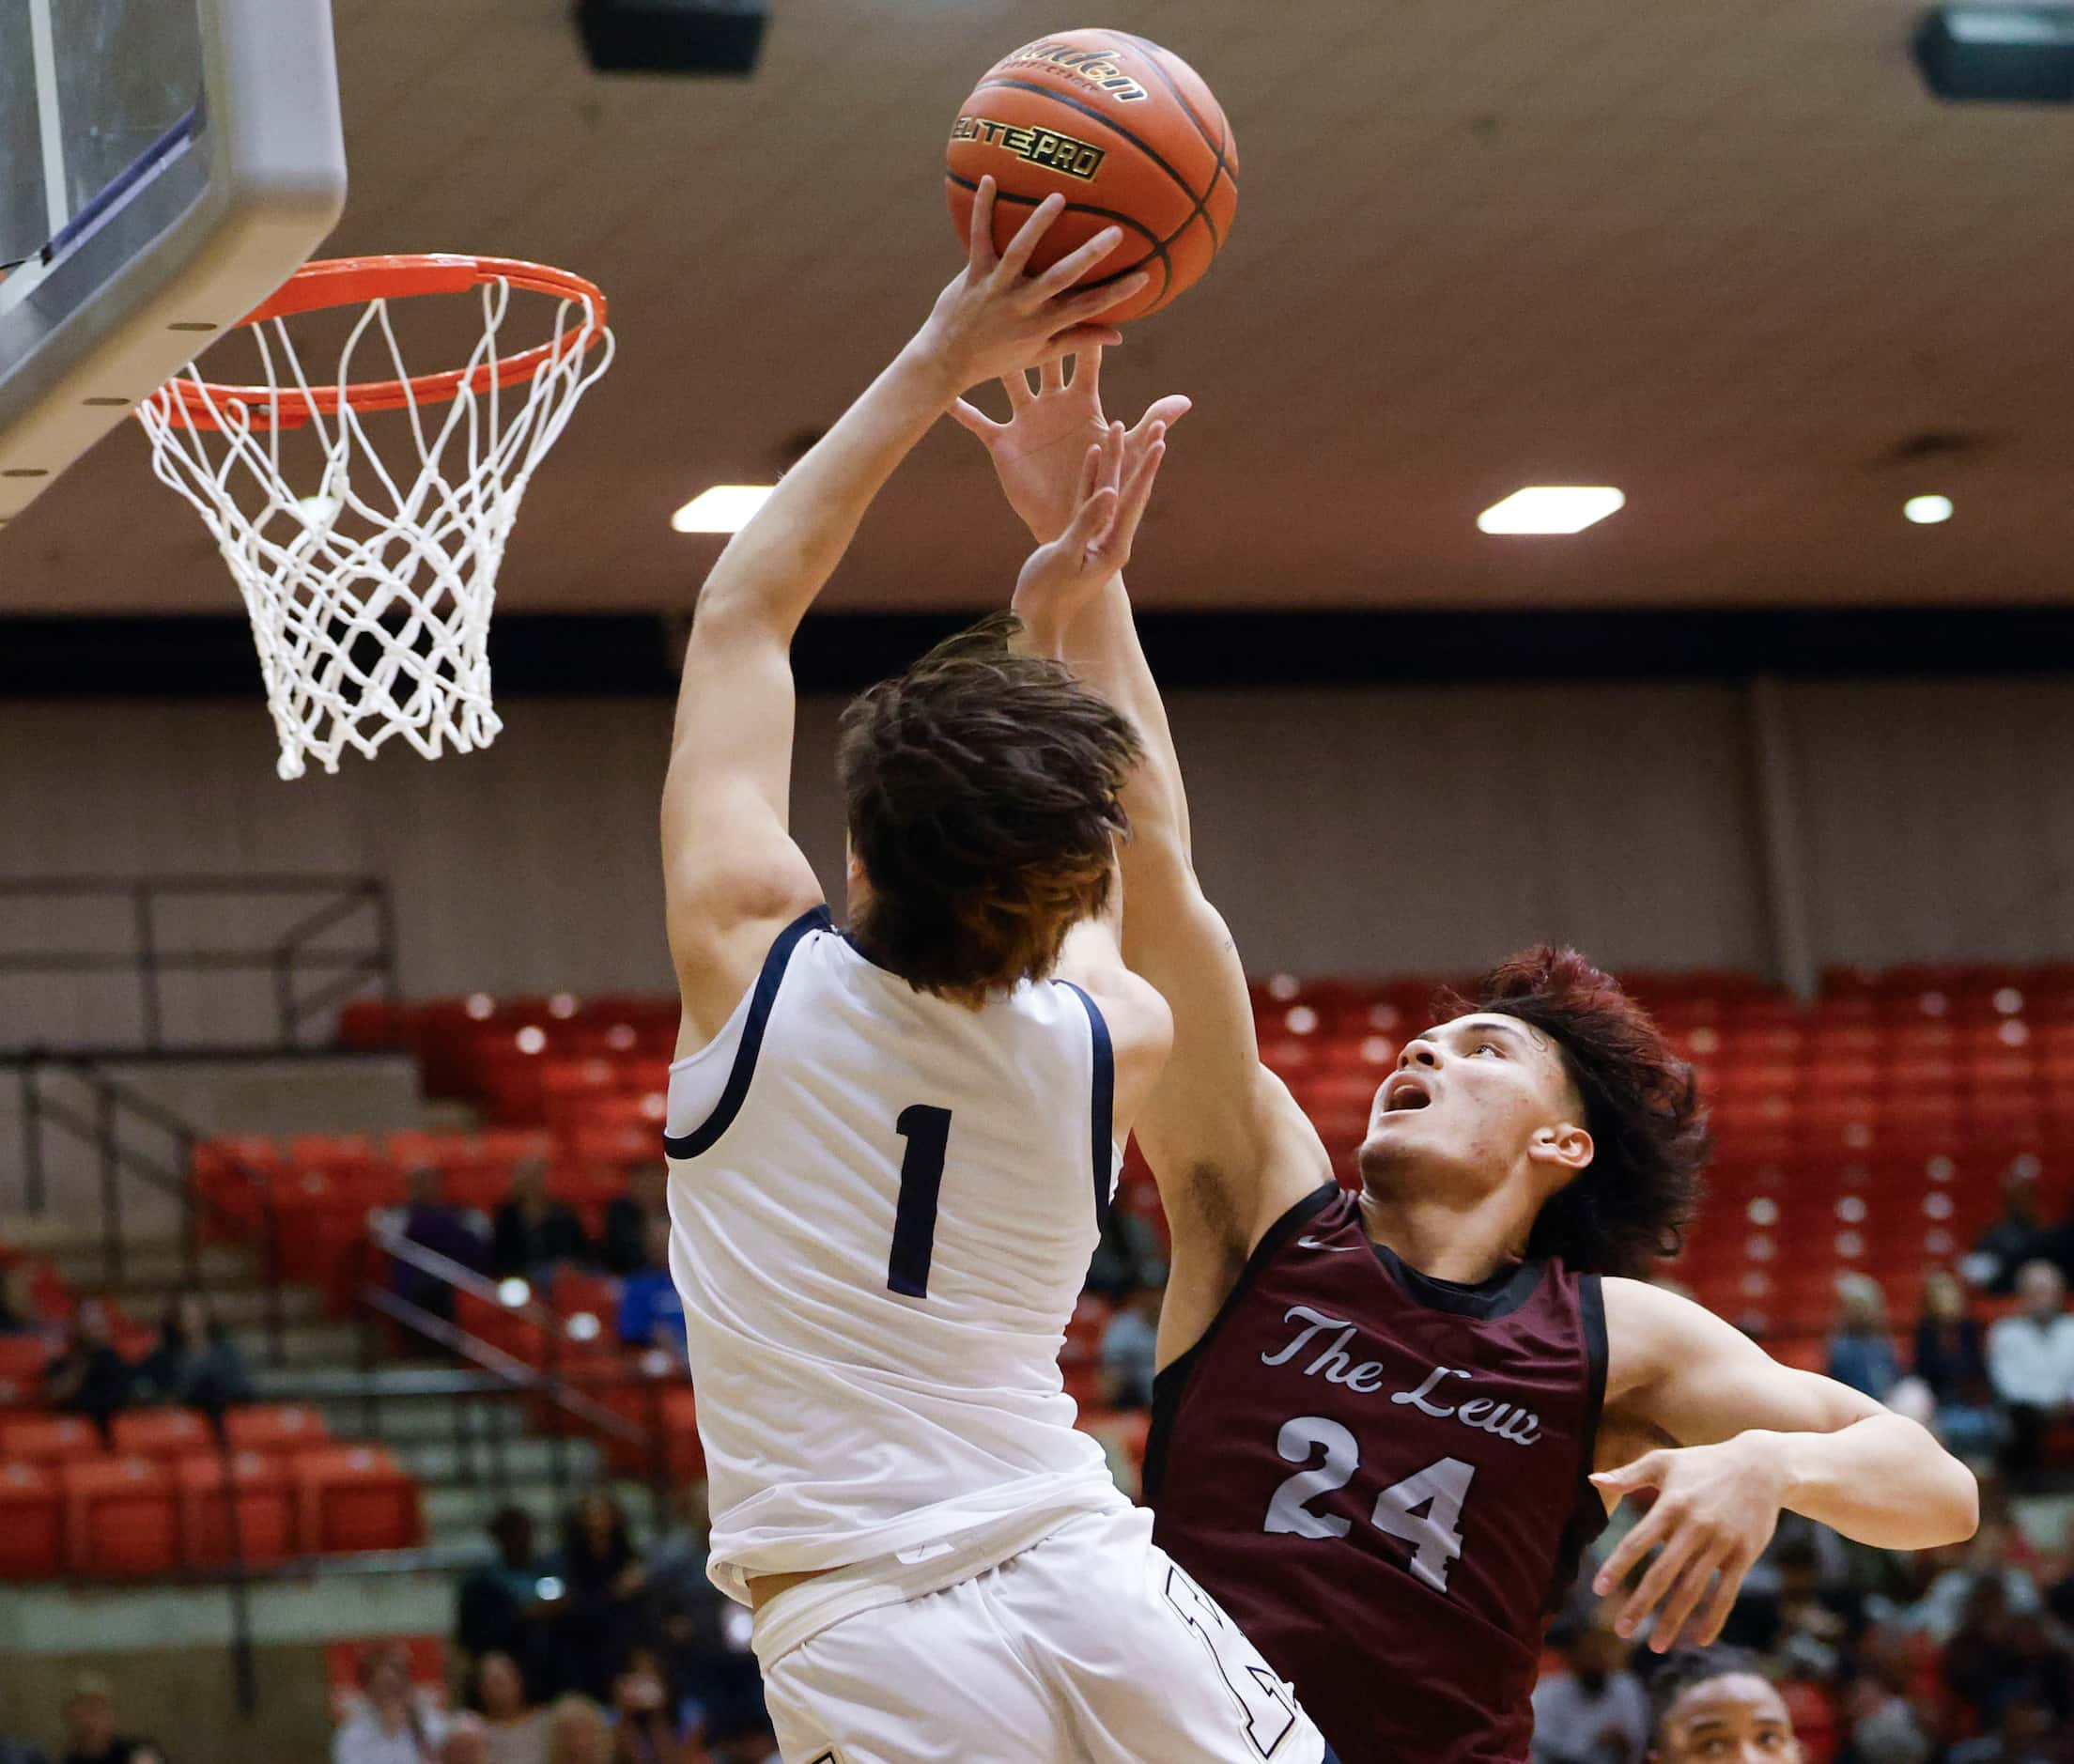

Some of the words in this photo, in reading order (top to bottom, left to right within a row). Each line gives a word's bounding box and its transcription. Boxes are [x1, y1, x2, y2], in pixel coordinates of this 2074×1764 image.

[887, 1104, 952, 1299] 1
[1261, 1305, 1384, 1393] The
[1390, 1366, 1542, 1447] Lew
[1263, 1416, 1476, 1594] 24
